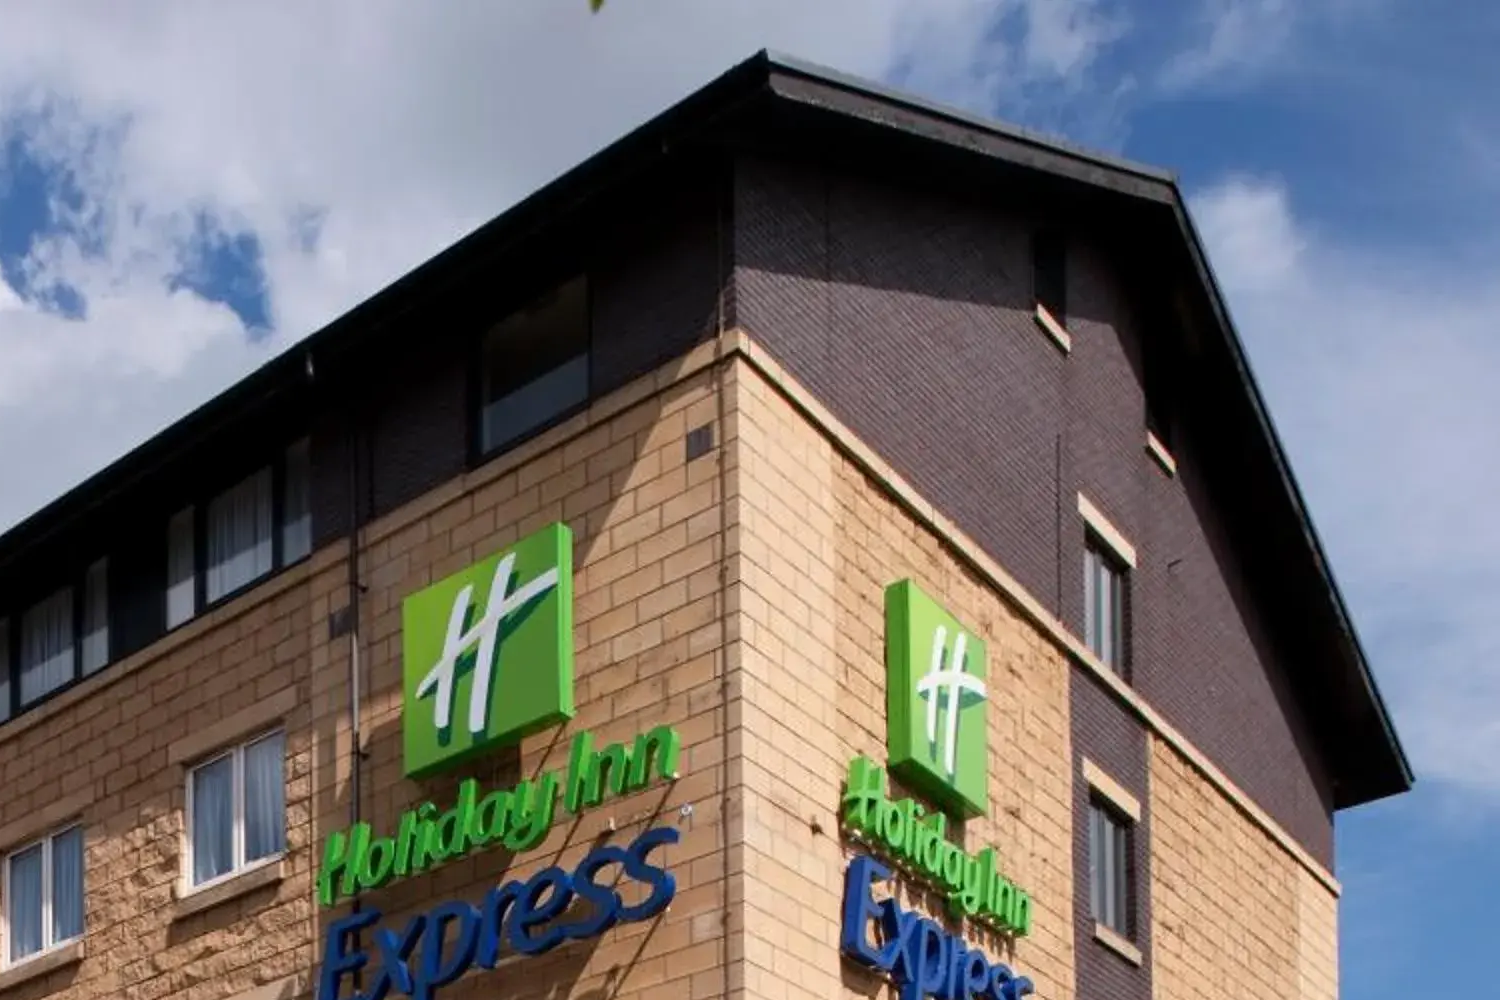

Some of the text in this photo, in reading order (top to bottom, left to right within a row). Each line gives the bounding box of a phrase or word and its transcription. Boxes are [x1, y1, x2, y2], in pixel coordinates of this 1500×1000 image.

[317, 725, 680, 906] Holiday Inn
[843, 756, 1032, 936] Holiday Inn
